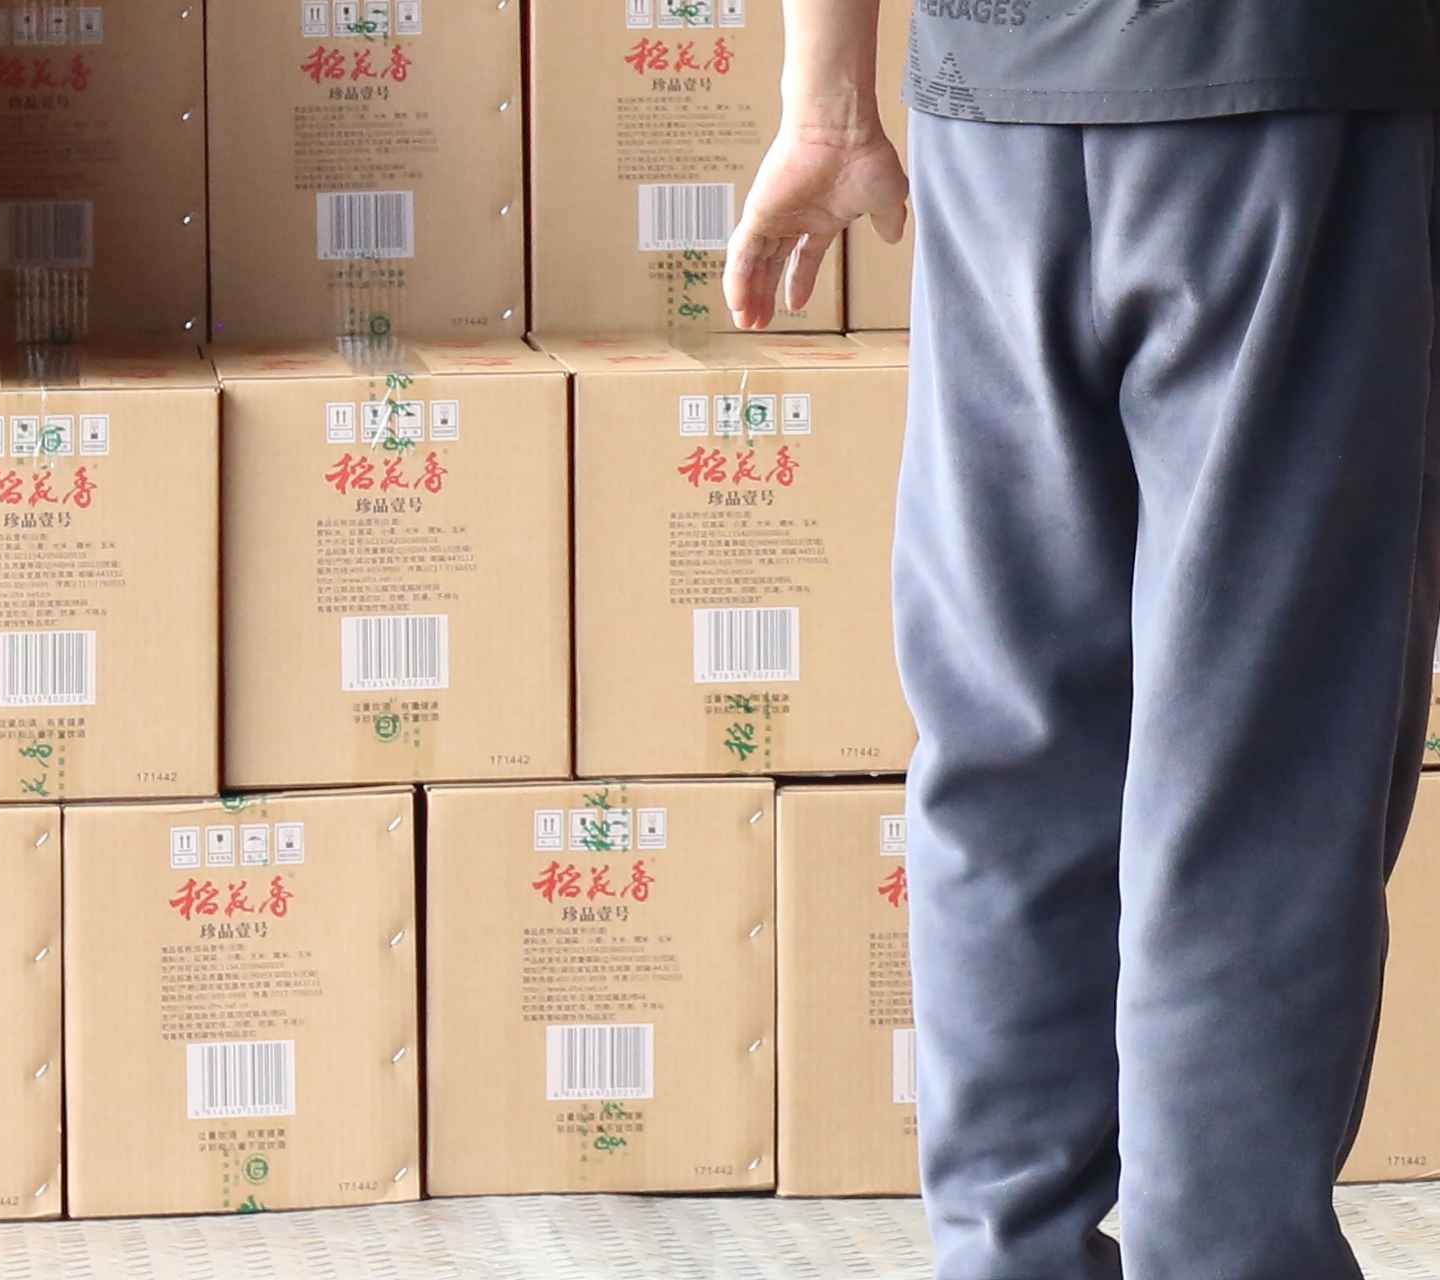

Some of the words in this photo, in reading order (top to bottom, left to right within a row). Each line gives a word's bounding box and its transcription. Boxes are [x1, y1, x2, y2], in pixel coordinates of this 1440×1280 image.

[302, 45, 411, 82] 稻花香
[325, 451, 445, 495] 稻花香
[676, 446, 801, 488] 稻花香
[2, 510, 72, 530] 珍品壹号
[168, 874, 290, 920] 稻花香
[530, 859, 652, 903] 稻花香
